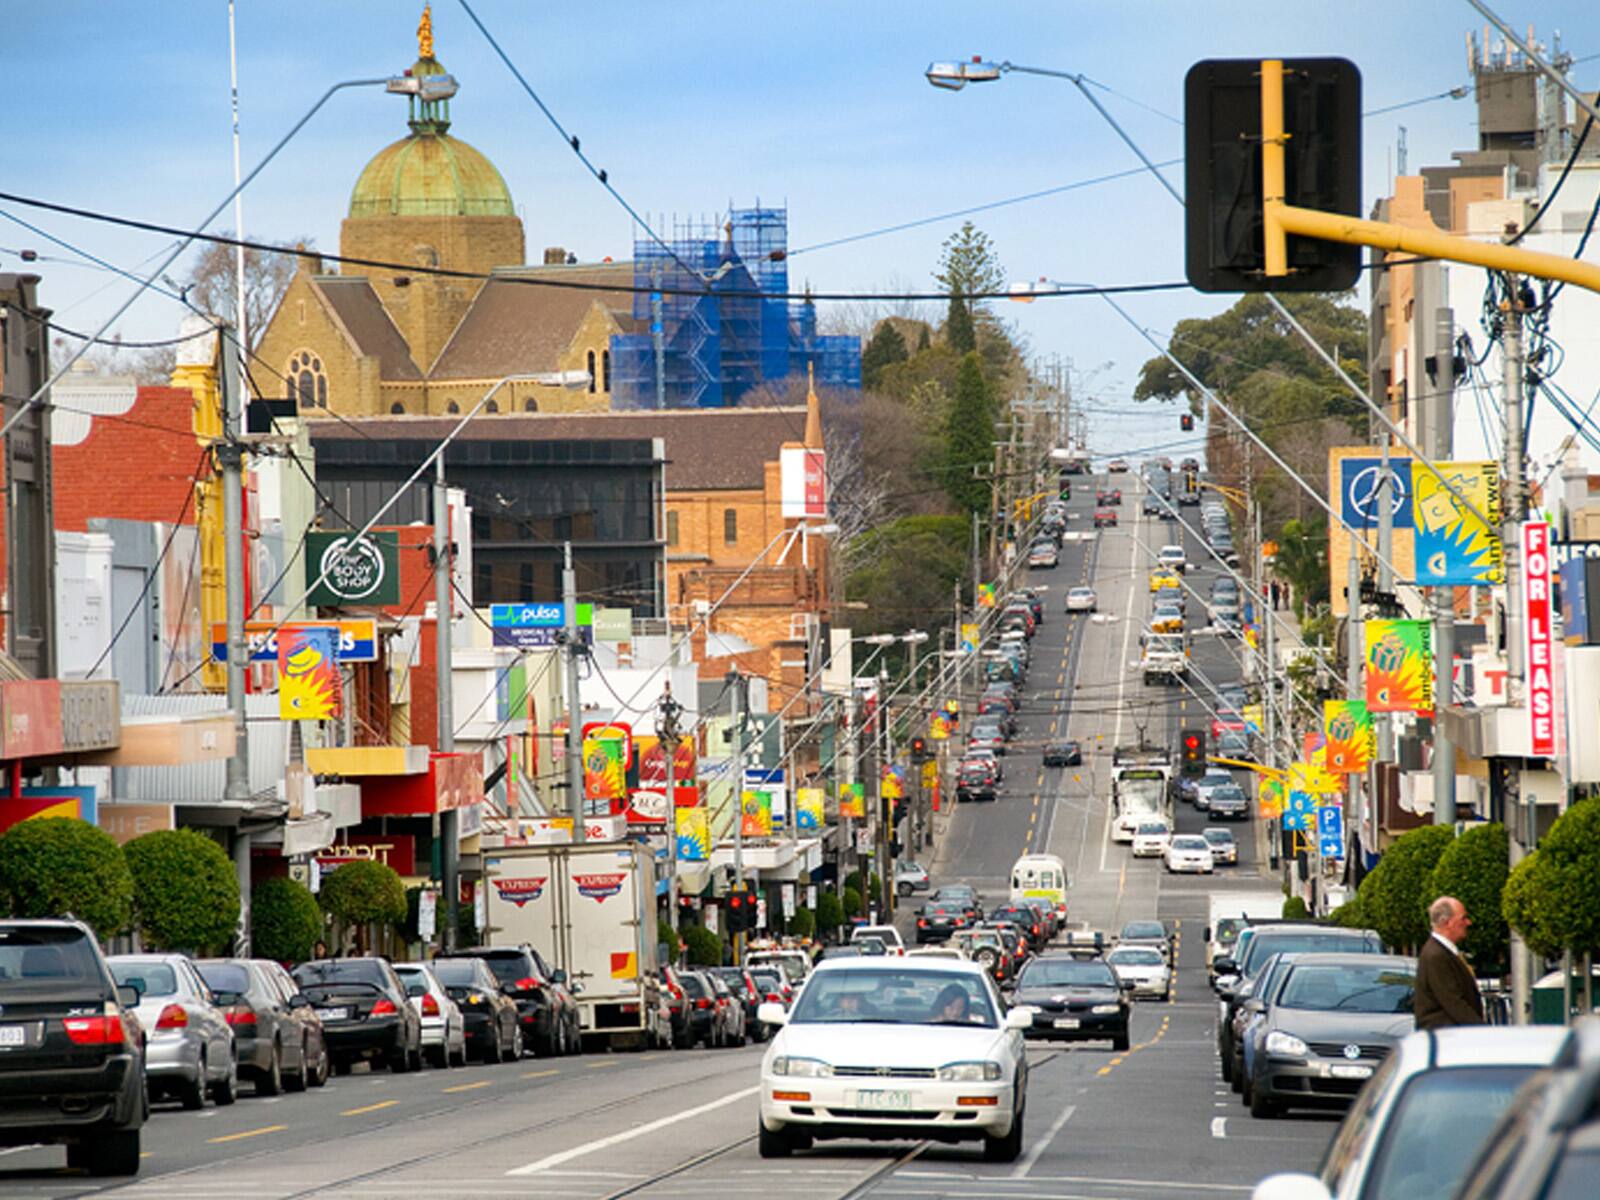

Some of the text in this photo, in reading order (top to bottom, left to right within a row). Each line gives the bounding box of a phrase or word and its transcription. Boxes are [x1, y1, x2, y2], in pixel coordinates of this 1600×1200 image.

[333, 566, 371, 579] BODY
[337, 578, 371, 588] SHOP
[521, 603, 561, 624] pulse
[1527, 529, 1553, 742] FOR LEASE
[1324, 809, 1336, 824] P
